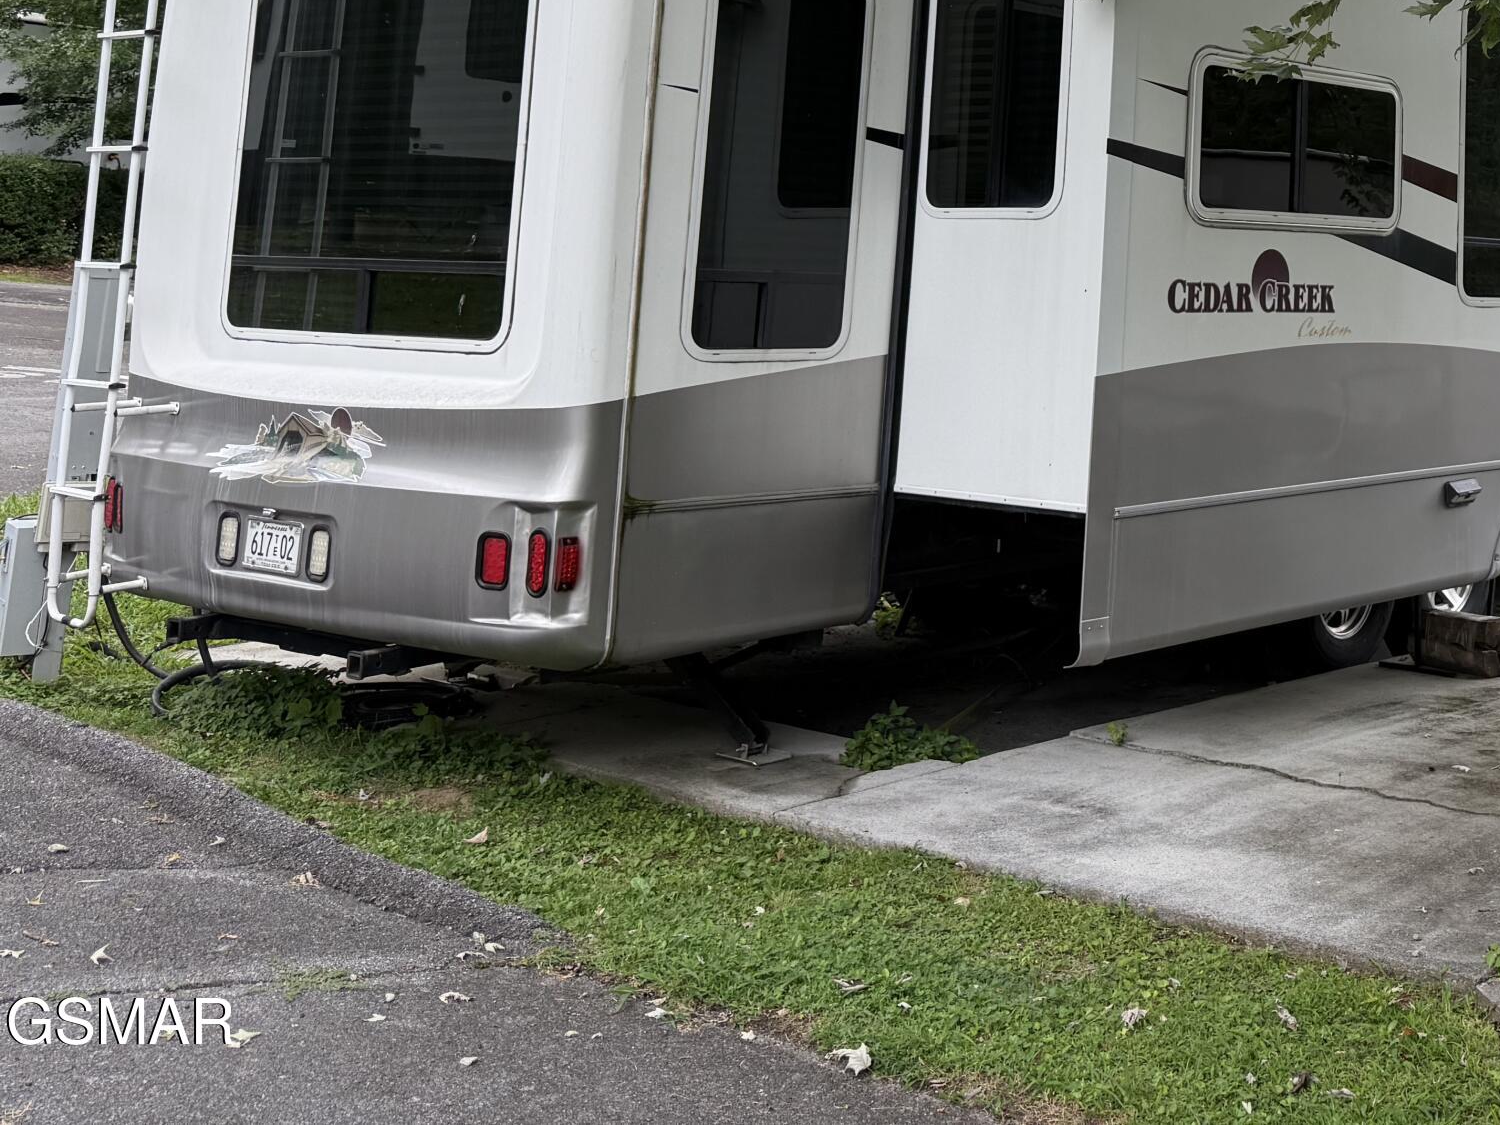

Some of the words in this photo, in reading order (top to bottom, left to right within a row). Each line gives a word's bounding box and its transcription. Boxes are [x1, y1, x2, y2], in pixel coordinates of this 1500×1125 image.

[1167, 279, 1253, 314] CEDAR
[1259, 279, 1335, 314] CREEK
[1298, 316, 1352, 338] Custom
